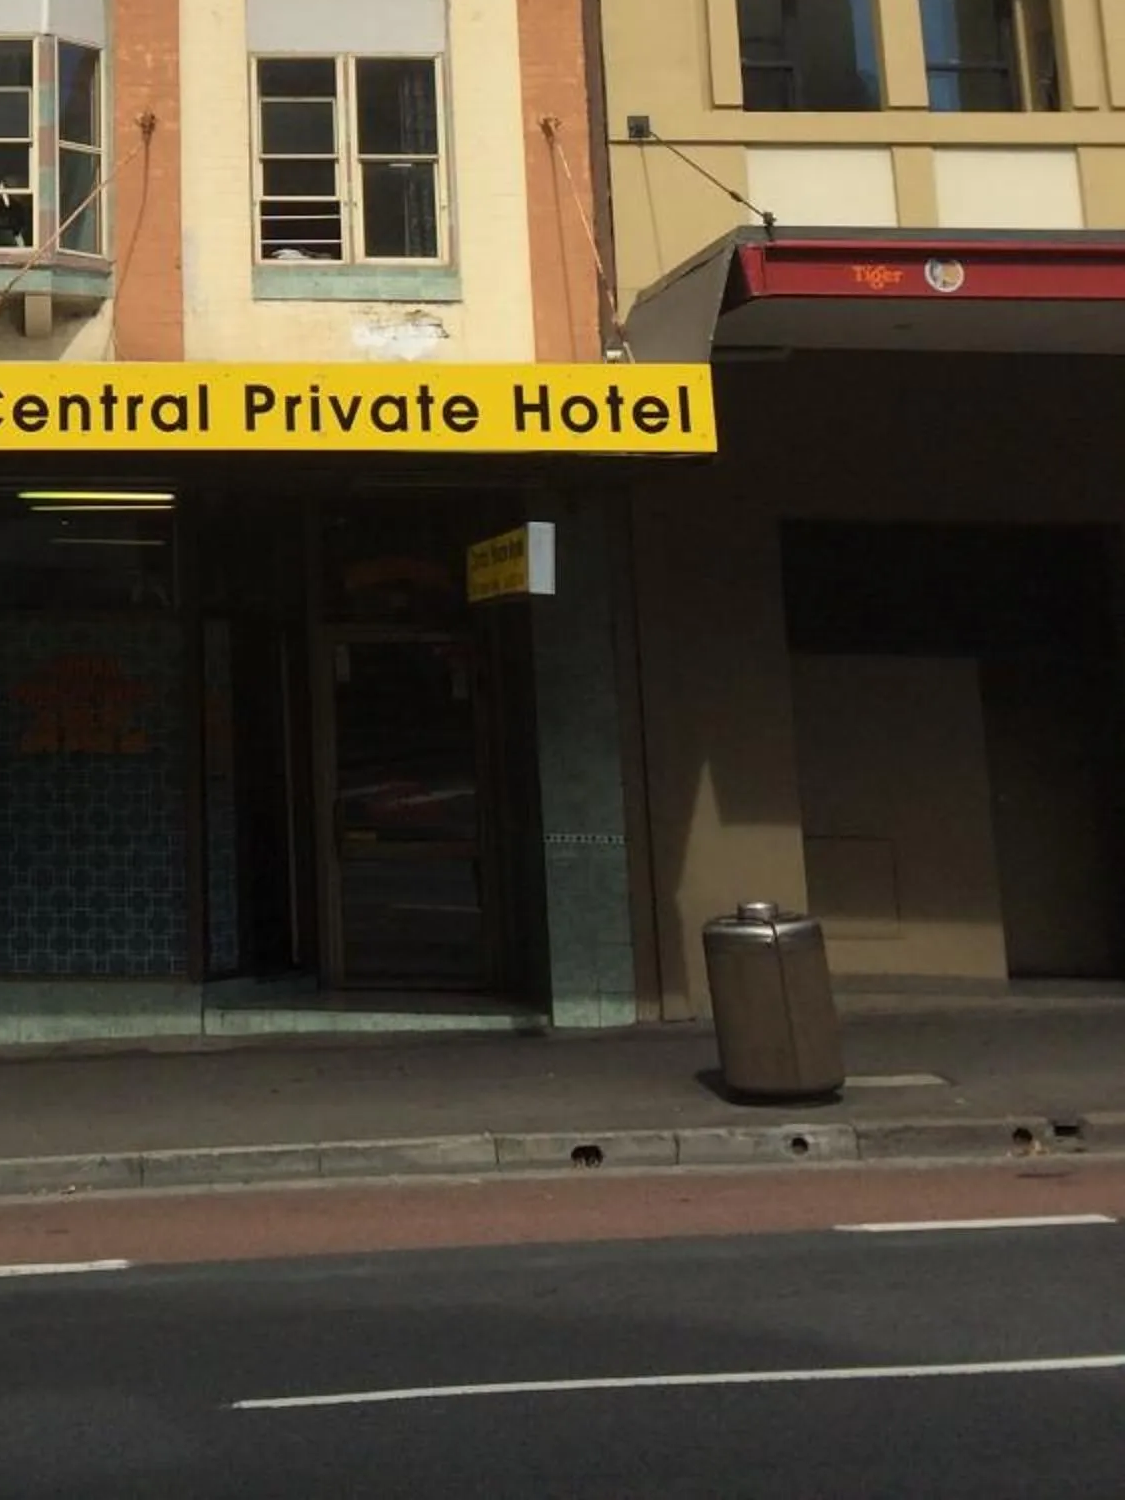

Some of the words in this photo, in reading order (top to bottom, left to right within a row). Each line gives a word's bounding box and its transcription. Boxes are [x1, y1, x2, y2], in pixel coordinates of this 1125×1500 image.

[852, 265, 903, 290] Tiger
[244, 383, 480, 433] Private
[513, 384, 692, 433] Hotel
